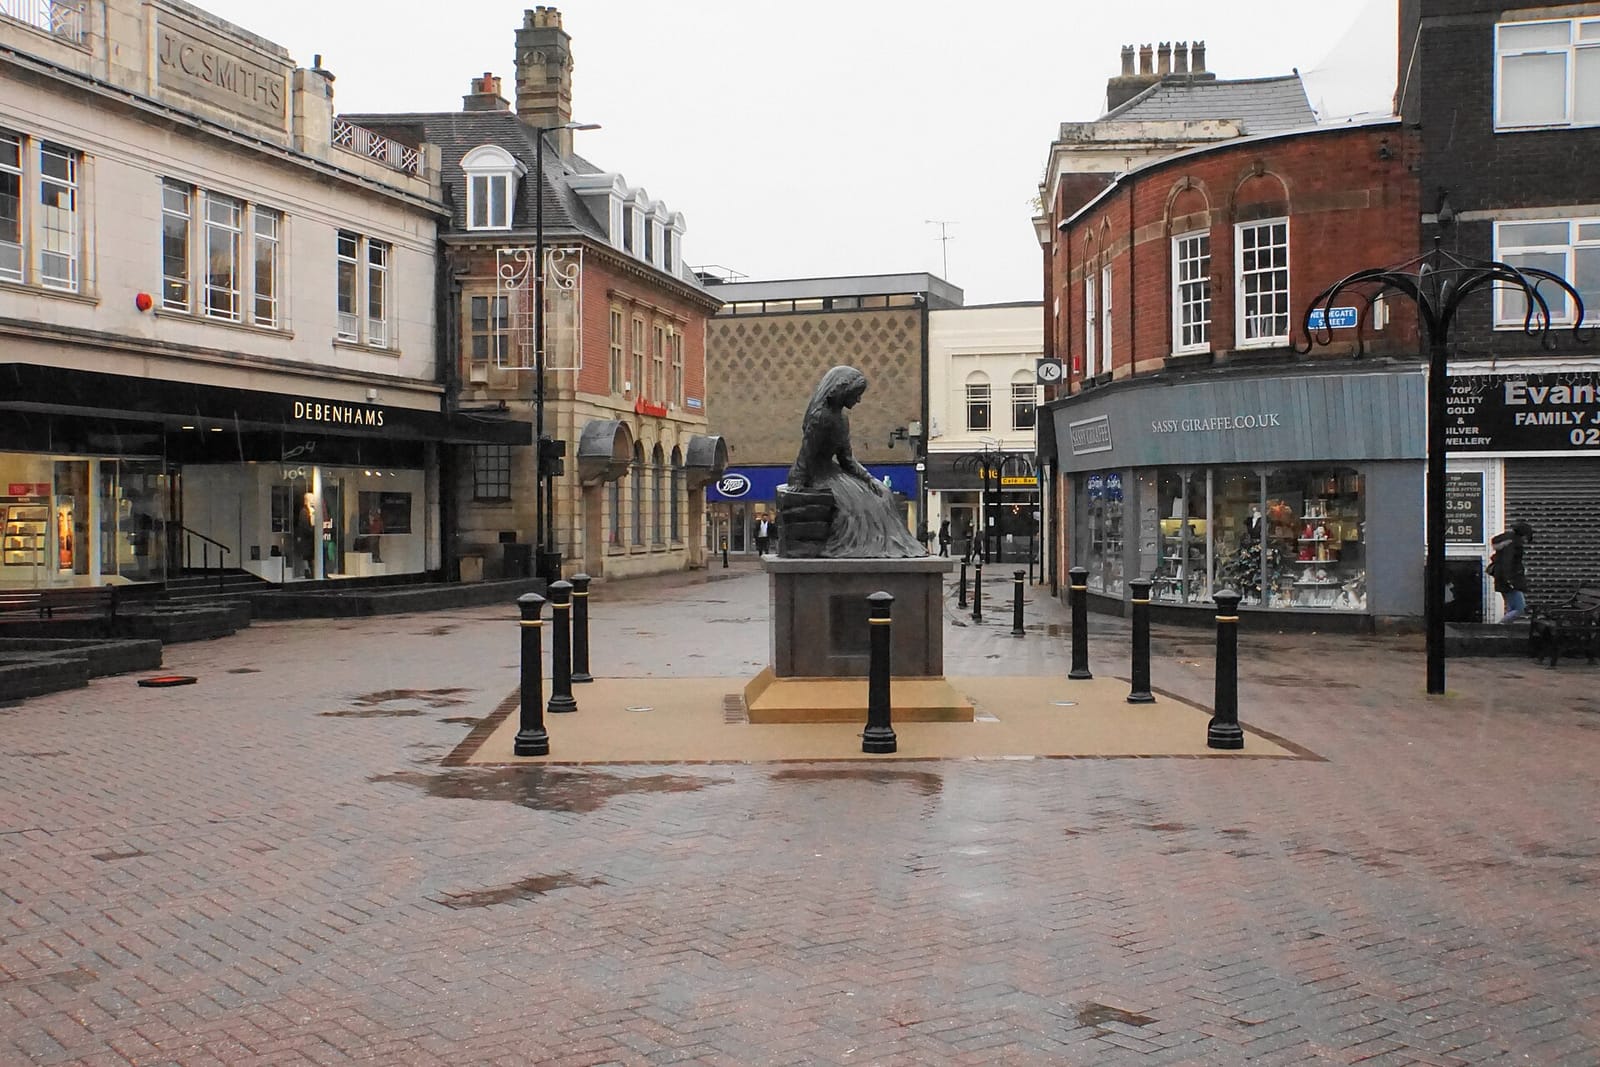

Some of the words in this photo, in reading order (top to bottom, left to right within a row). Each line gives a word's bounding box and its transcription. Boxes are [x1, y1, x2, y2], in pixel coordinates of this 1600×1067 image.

[1310, 310, 1354, 319] NEWEGATE
[1044, 366, 1055, 377] K
[1450, 386, 1471, 395] TOP
[1504, 381, 1600, 405] Evan
[1446, 396, 1483, 405] UALITY
[294, 401, 384, 426] DEBENHAMS
[1446, 406, 1475, 415] GOLD
[1152, 420, 1178, 433] SASSY
[1181, 413, 1281, 432] GIRAFFE.CO.UK
[1456, 416, 1465, 425] &
[1515, 412, 1585, 425] FAMILY
[1445, 426, 1480, 435] ILVER
[1445, 437, 1492, 445] WELLERY
[1570, 428, 1600, 445] 02
